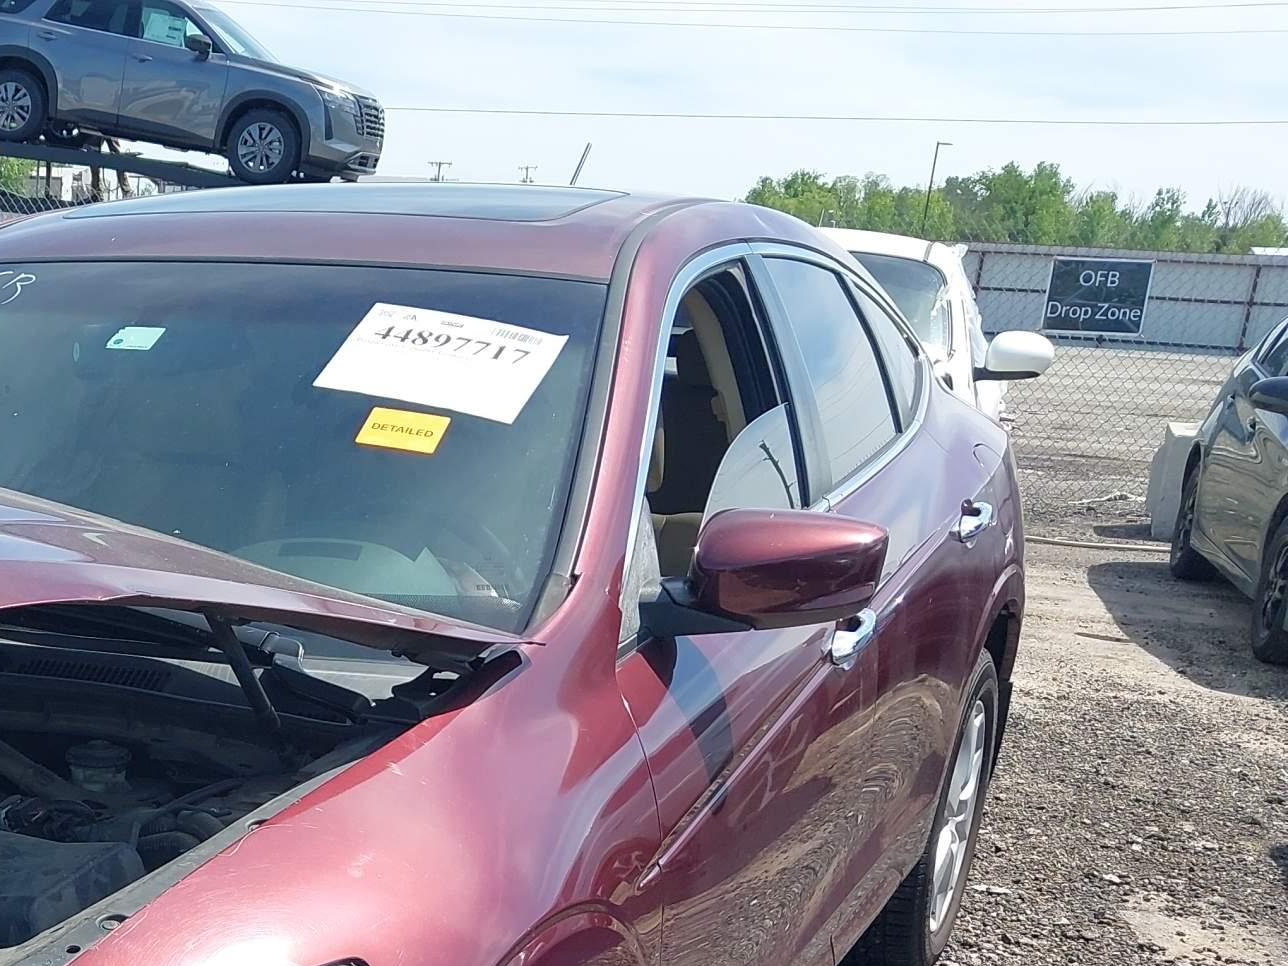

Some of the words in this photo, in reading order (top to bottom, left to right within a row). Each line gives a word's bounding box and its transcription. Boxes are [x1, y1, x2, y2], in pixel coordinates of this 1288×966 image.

[1079, 270, 1120, 287] OFB
[1046, 301, 1092, 321] Drop
[1094, 303, 1141, 321] Zone
[373, 323, 532, 365] 44897717
[370, 421, 434, 439] DETAILED
